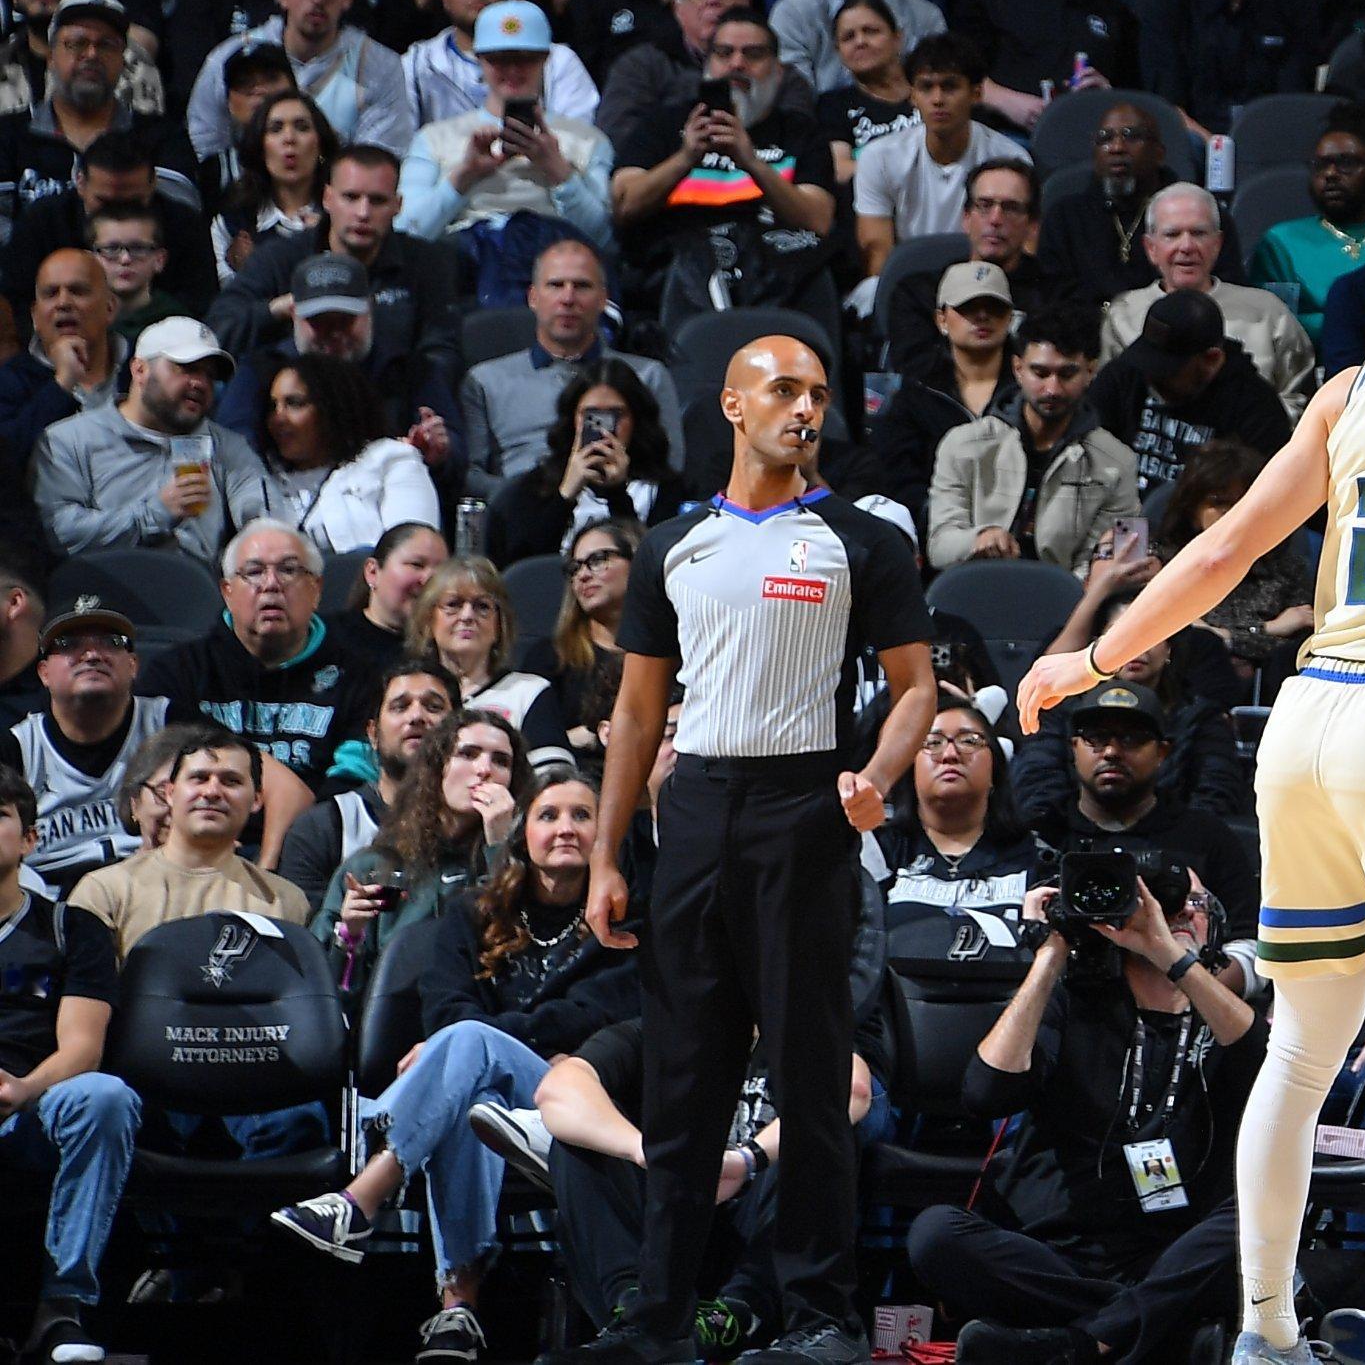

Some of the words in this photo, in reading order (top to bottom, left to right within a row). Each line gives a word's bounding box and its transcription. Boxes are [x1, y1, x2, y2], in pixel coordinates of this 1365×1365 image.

[764, 580, 824, 599] Emirates
[166, 1026, 218, 1043] MACK
[223, 1025, 290, 1042] INJURY
[171, 1046, 280, 1064] ATTORNEYS
